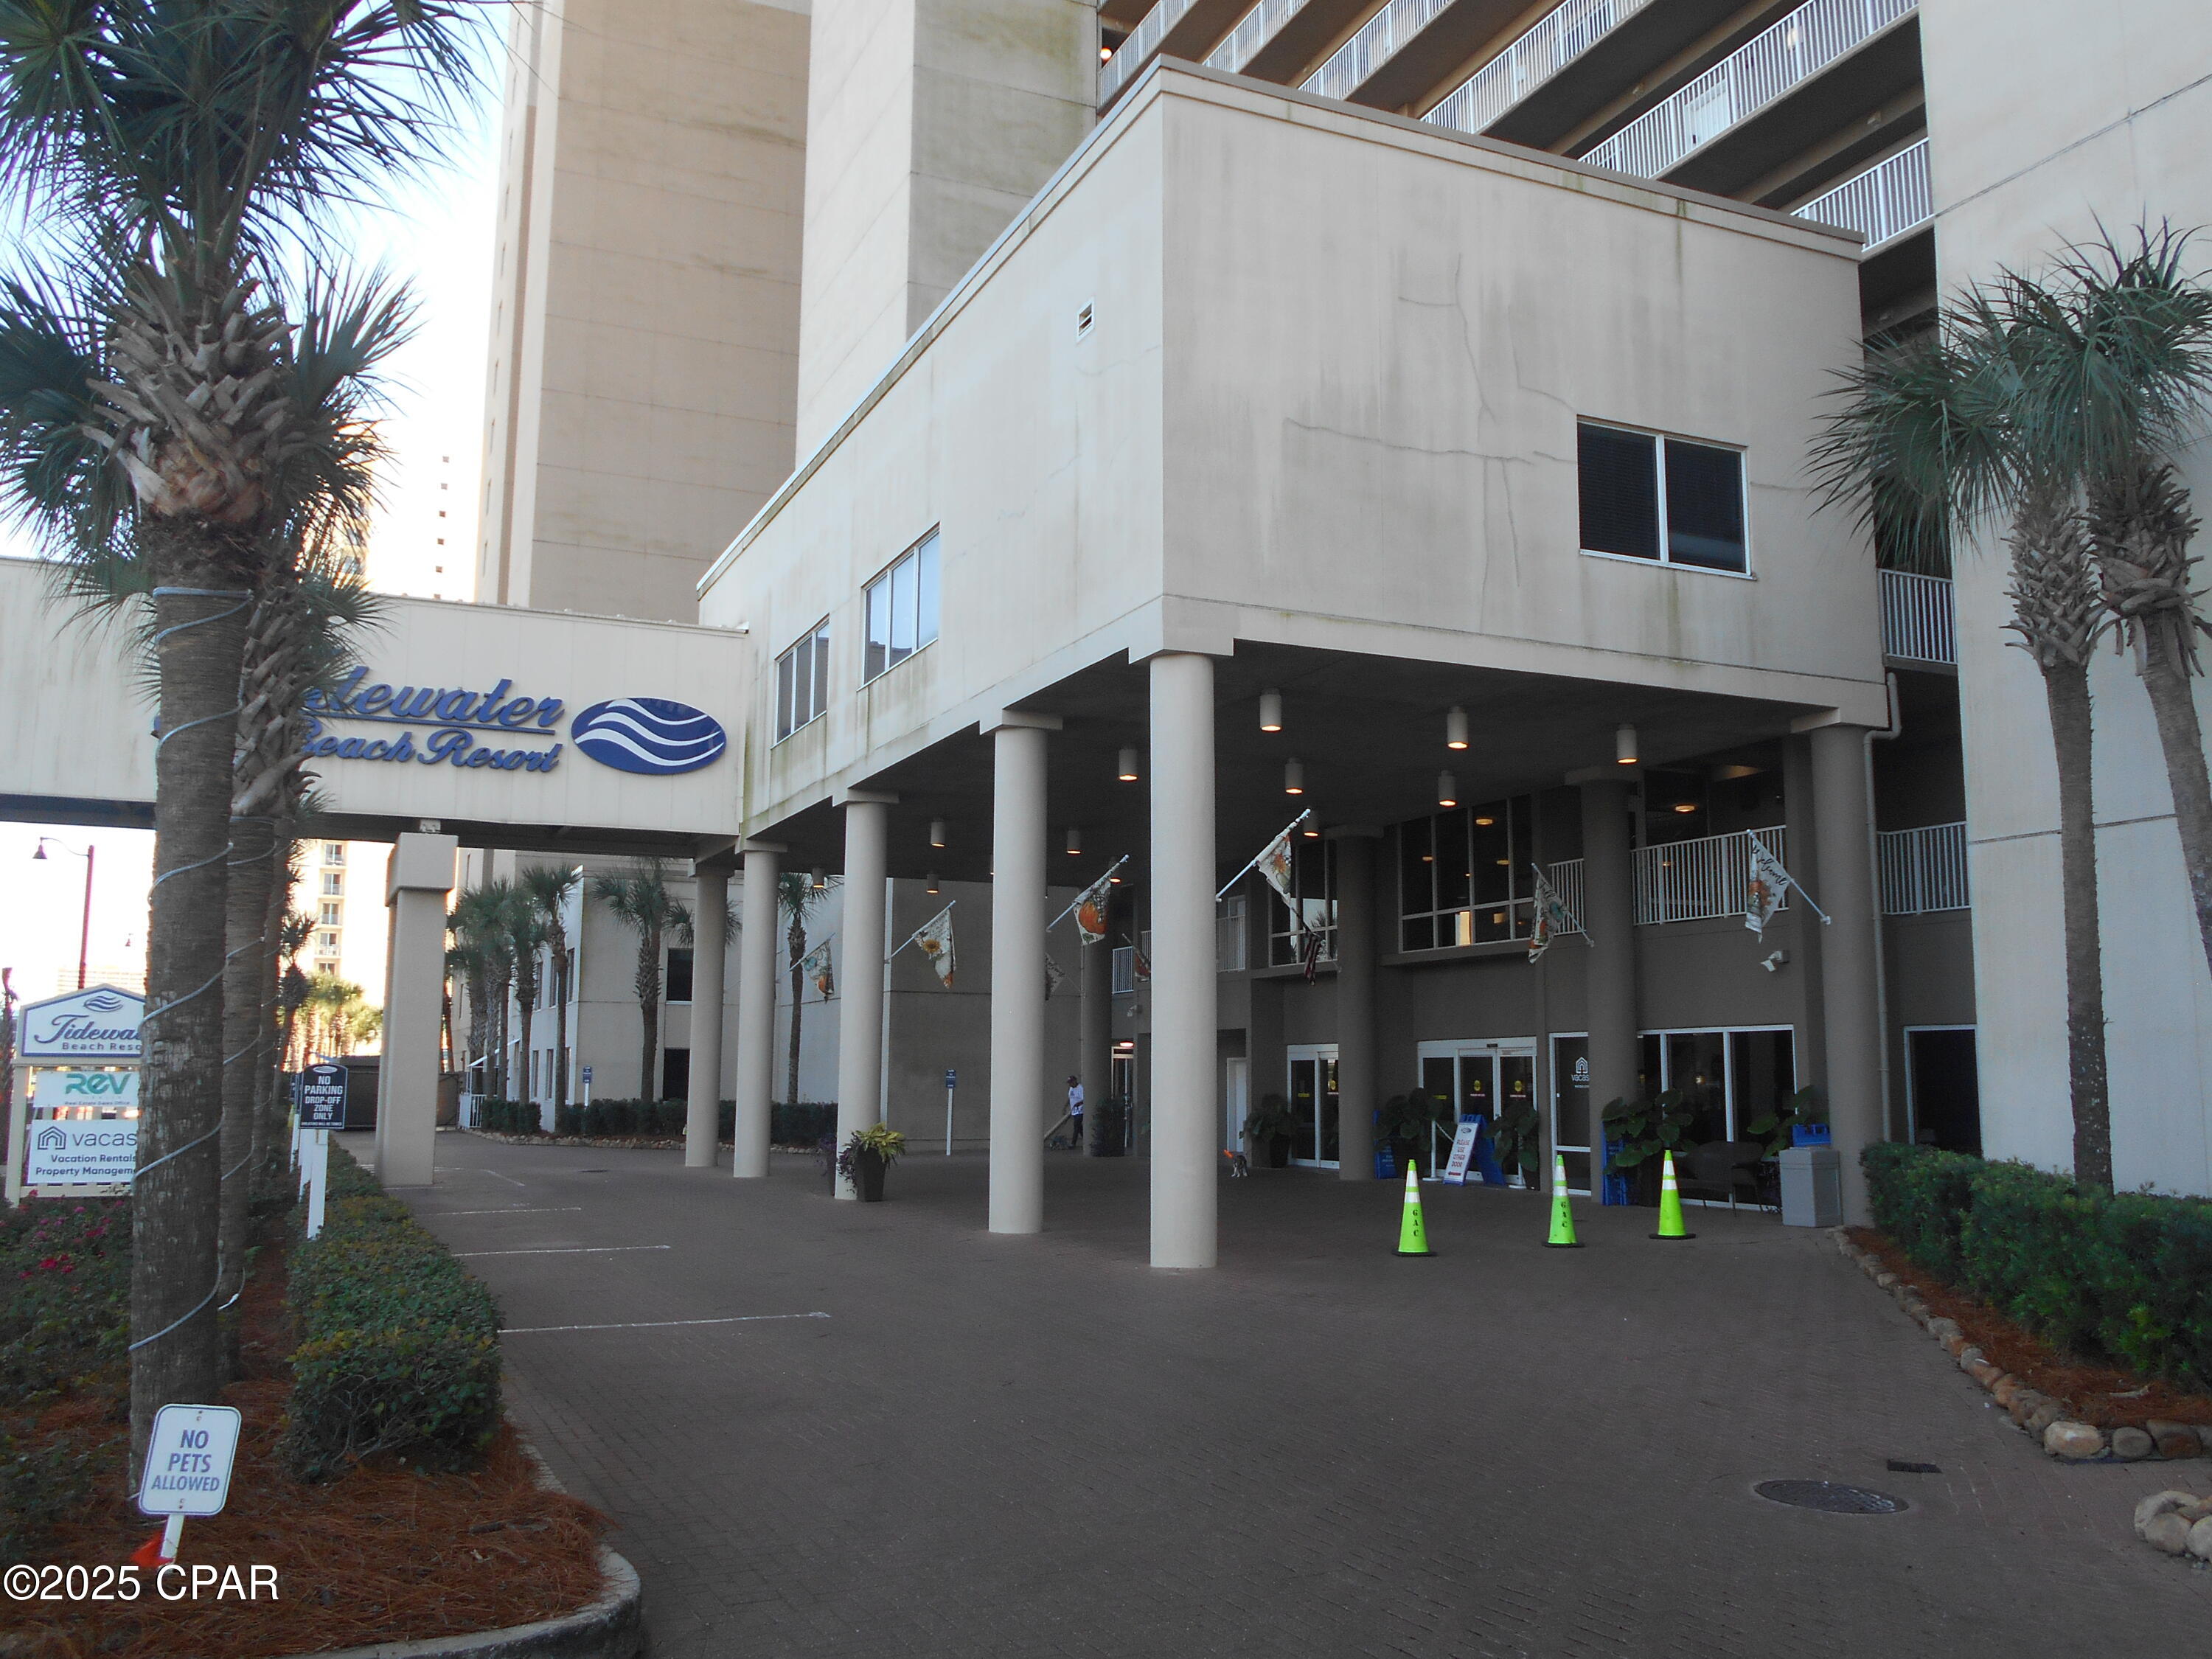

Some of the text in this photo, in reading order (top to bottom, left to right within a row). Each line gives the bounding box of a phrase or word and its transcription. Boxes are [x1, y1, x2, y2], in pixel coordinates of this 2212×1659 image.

[303, 664, 566, 728] dewater
[418, 728, 563, 773] Resort
[34, 1014, 142, 1044] Tidewa
[62, 1042, 142, 1051] Beach Reso
[318, 1076, 331, 1085] NO
[304, 1085, 344, 1095] PARKING
[305, 1096, 341, 1105] DROP-OFF
[313, 1112, 333, 1120] ONLY
[72, 1133, 137, 1147] vacas
[51, 1154, 97, 1163] Vacation
[35, 1166, 136, 1178] Property Managem
[179, 1430, 209, 1450] NO
[167, 1453, 212, 1473] PETS
[151, 1475, 220, 1492] ALLOWED
